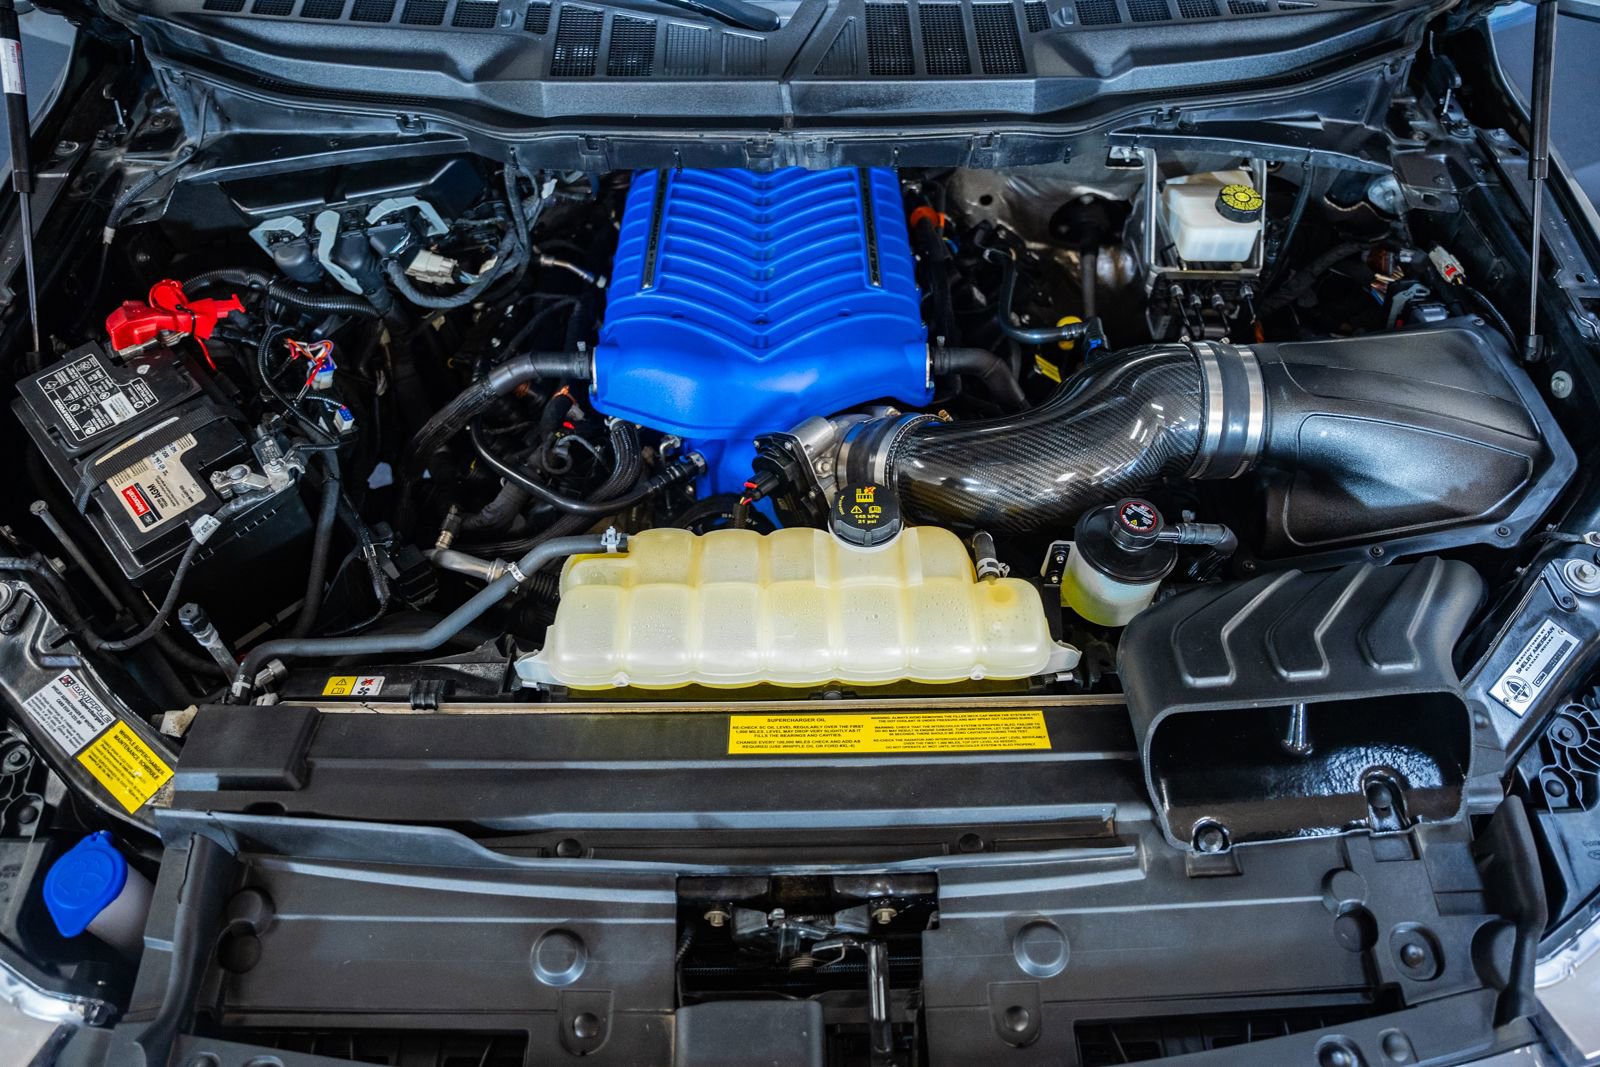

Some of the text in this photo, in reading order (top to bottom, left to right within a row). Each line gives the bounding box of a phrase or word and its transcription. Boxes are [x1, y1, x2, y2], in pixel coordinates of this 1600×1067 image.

[125, 488, 146, 513] Motorcraft
[147, 483, 162, 500] AGM
[1516, 626, 1555, 674] SHELBY AMERICAN
[71, 682, 113, 725] WHIPPLE
[1513, 683, 1528, 701] SHELBY
[78, 698, 105, 727] Superchargers
[113, 734, 140, 761] MAINTENANCE
[138, 759, 160, 781] SCHEDULE
[118, 729, 136, 747] WHIPPLE
[134, 744, 165, 776] SUPERCHARGER
